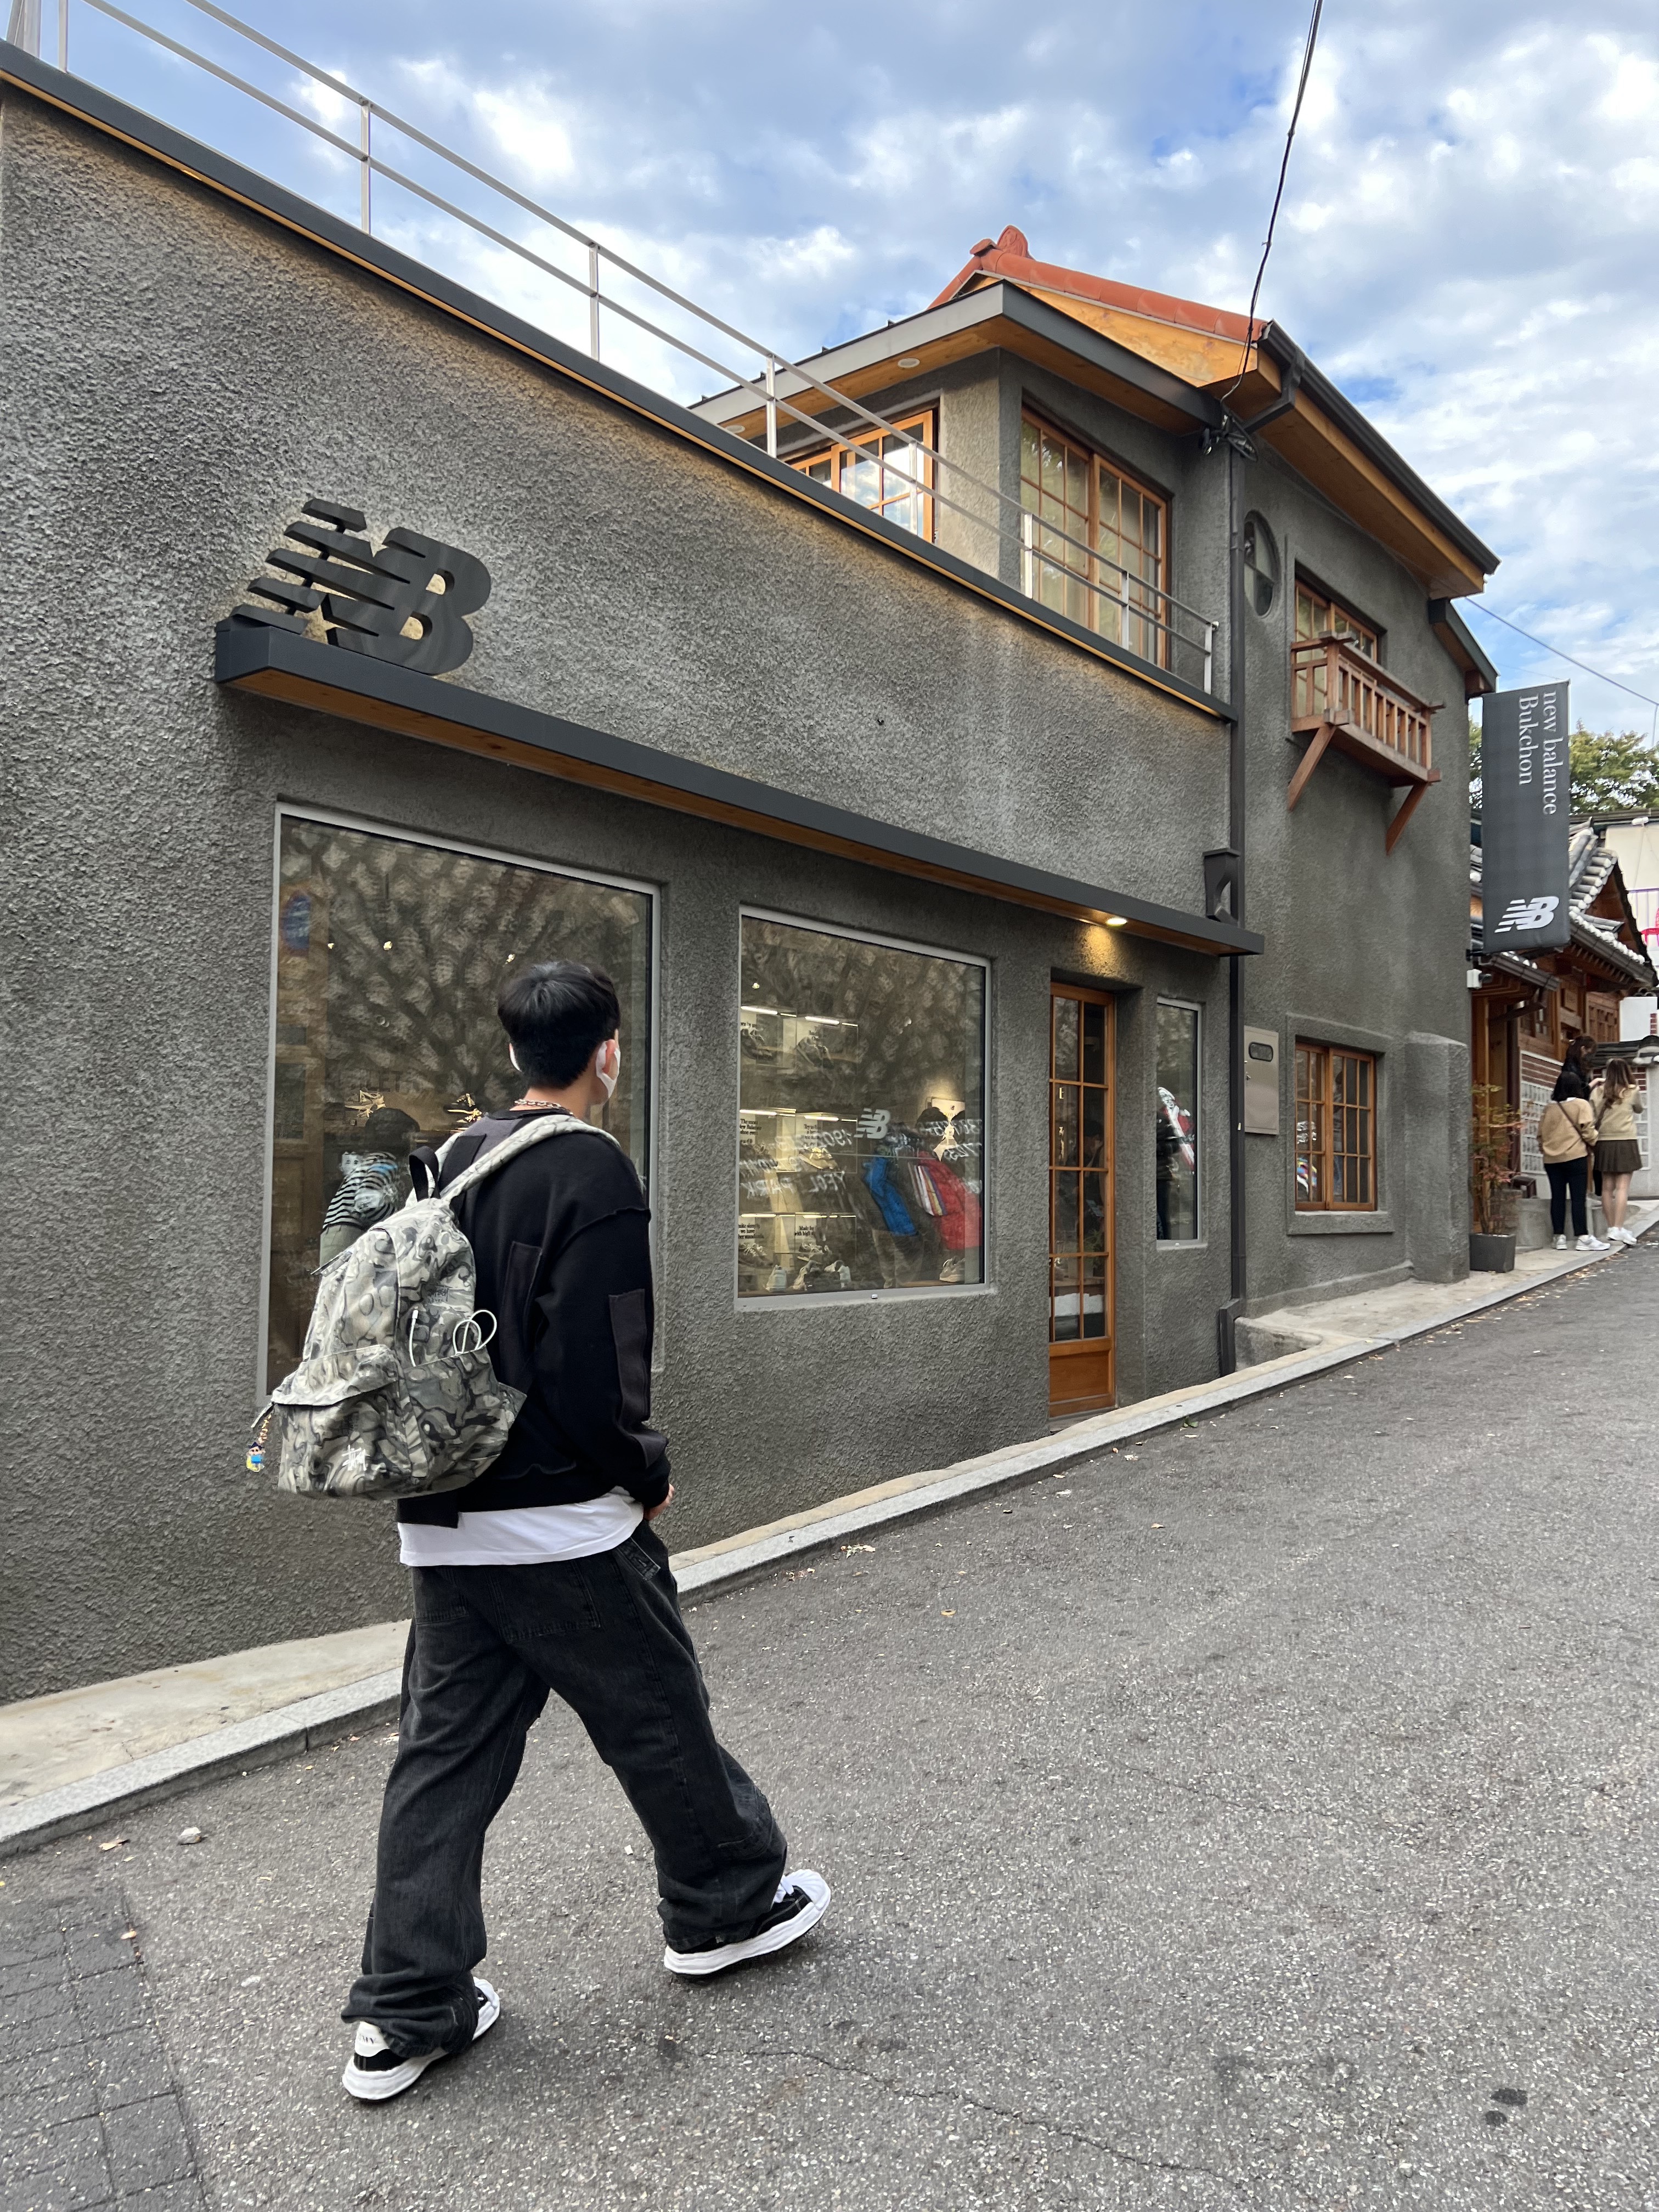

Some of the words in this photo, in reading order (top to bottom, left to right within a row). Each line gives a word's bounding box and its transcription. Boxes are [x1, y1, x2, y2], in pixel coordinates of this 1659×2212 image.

[231, 498, 492, 675] NB
[1519, 695, 1539, 786] Bukchon
[1543, 690, 1556, 732] new
[1543, 737, 1564, 815] balance
[1494, 896, 1560, 933] NB
[854, 1108, 890, 1139] NB
